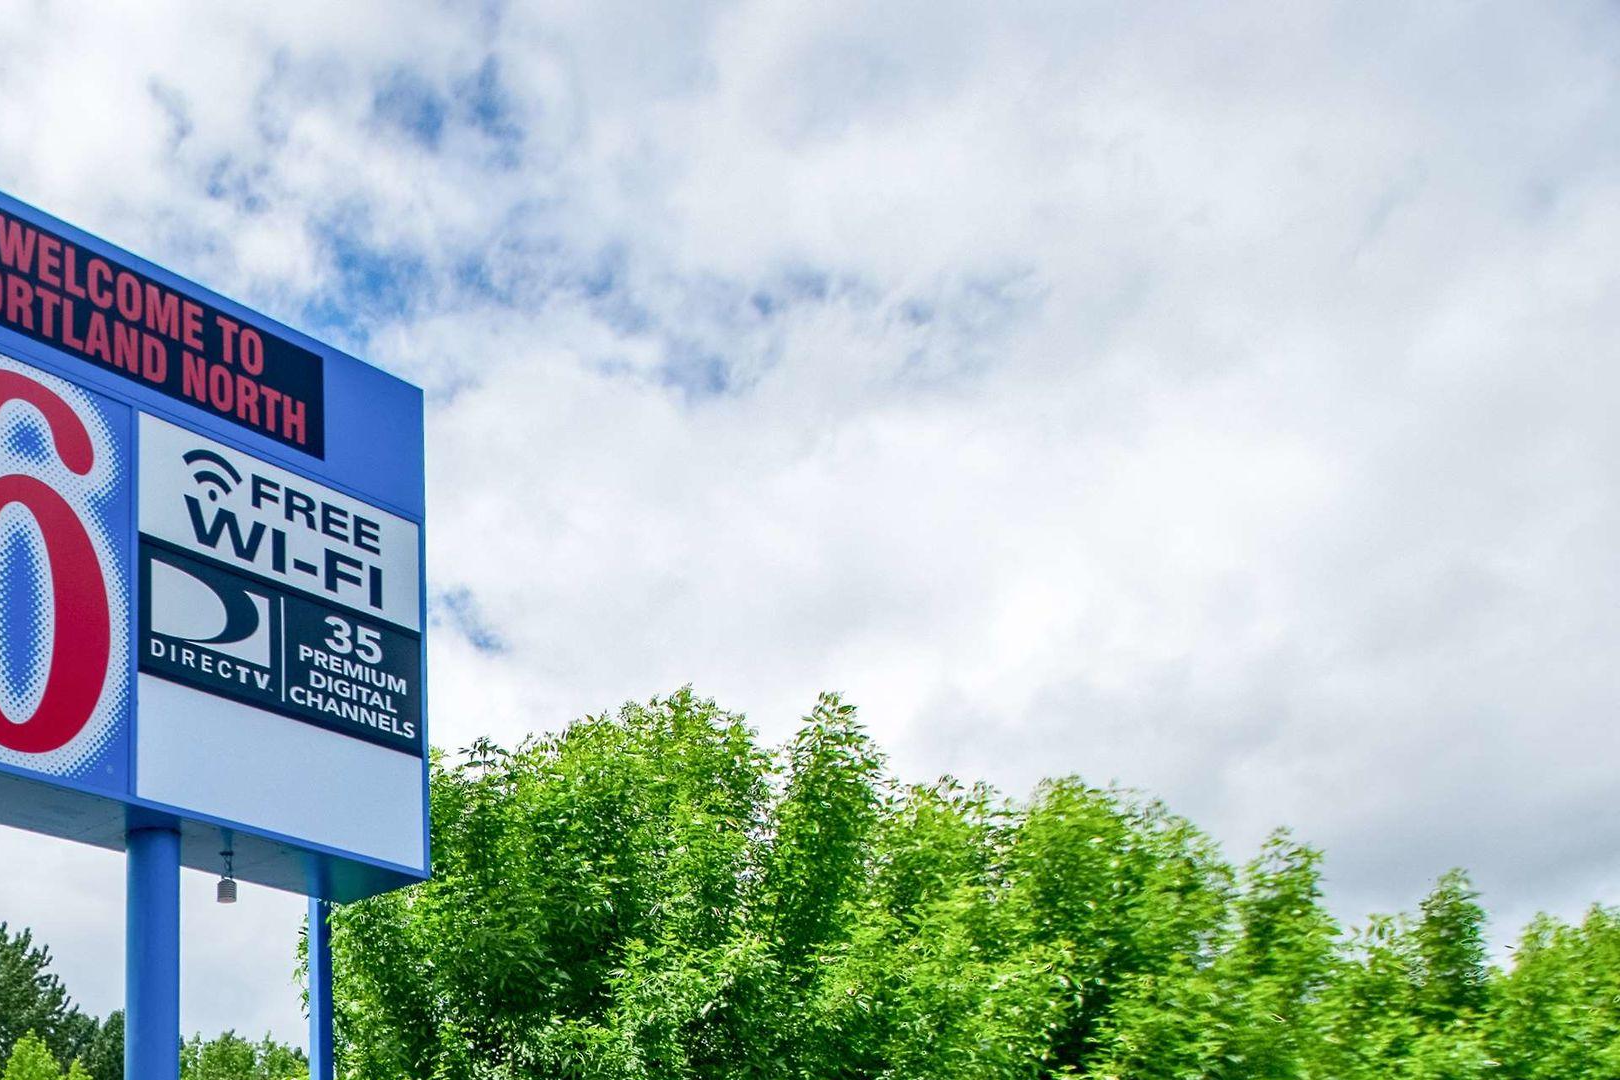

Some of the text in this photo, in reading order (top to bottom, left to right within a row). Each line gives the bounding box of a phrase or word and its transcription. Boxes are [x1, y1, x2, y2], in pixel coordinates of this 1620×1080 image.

[216, 315, 265, 377] TO
[182, 348, 306, 446] NORTH
[250, 472, 381, 556] FREE
[183, 493, 384, 611] WI-FI
[150, 637, 271, 692] DIRECTV
[323, 614, 384, 666] 35
[298, 643, 408, 697] PREMIUM
[309, 669, 398, 715] DIGITAL
[288, 684, 416, 740] CHANNELS
